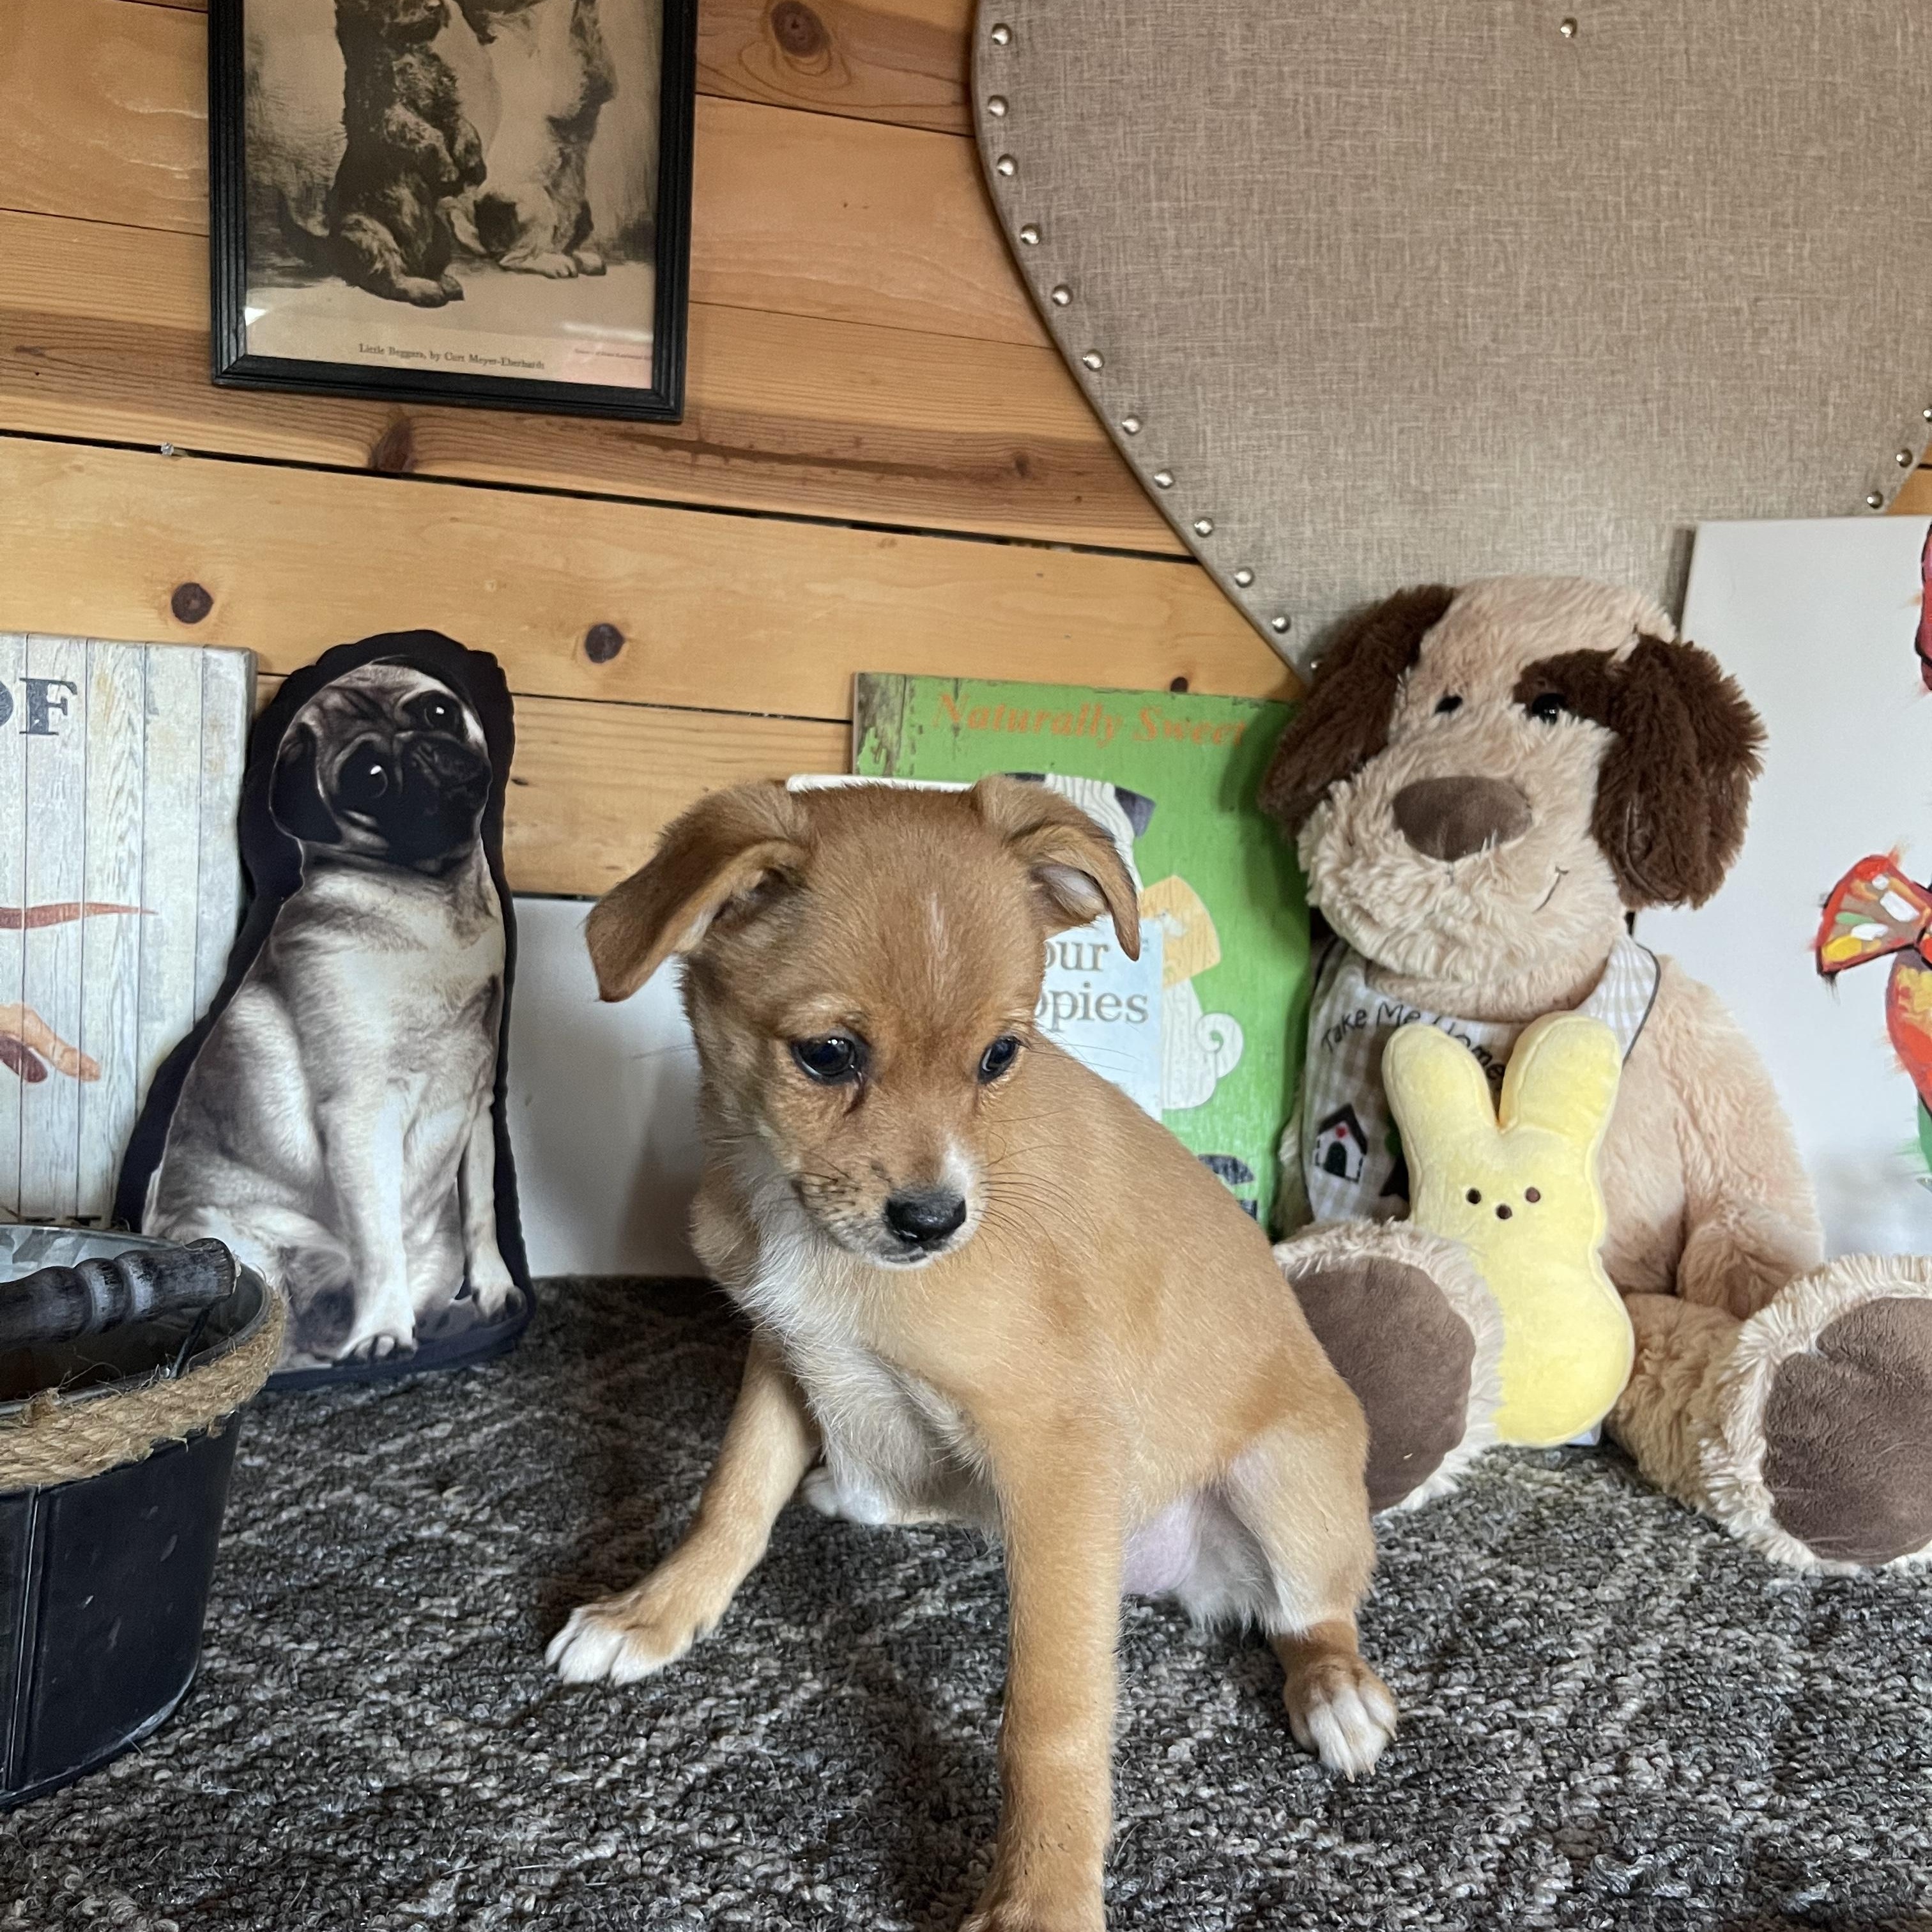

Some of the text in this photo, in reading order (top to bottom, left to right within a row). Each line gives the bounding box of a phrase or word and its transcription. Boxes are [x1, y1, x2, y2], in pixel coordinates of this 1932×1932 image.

[359, 342, 385, 355] Little
[429, 350, 441, 362] by
[444, 351, 464, 362] Curt
[0, 678, 77, 735] F
[932, 693, 1246, 748] Naturally Sweet
[1321, 1008, 1367, 1054] Take
